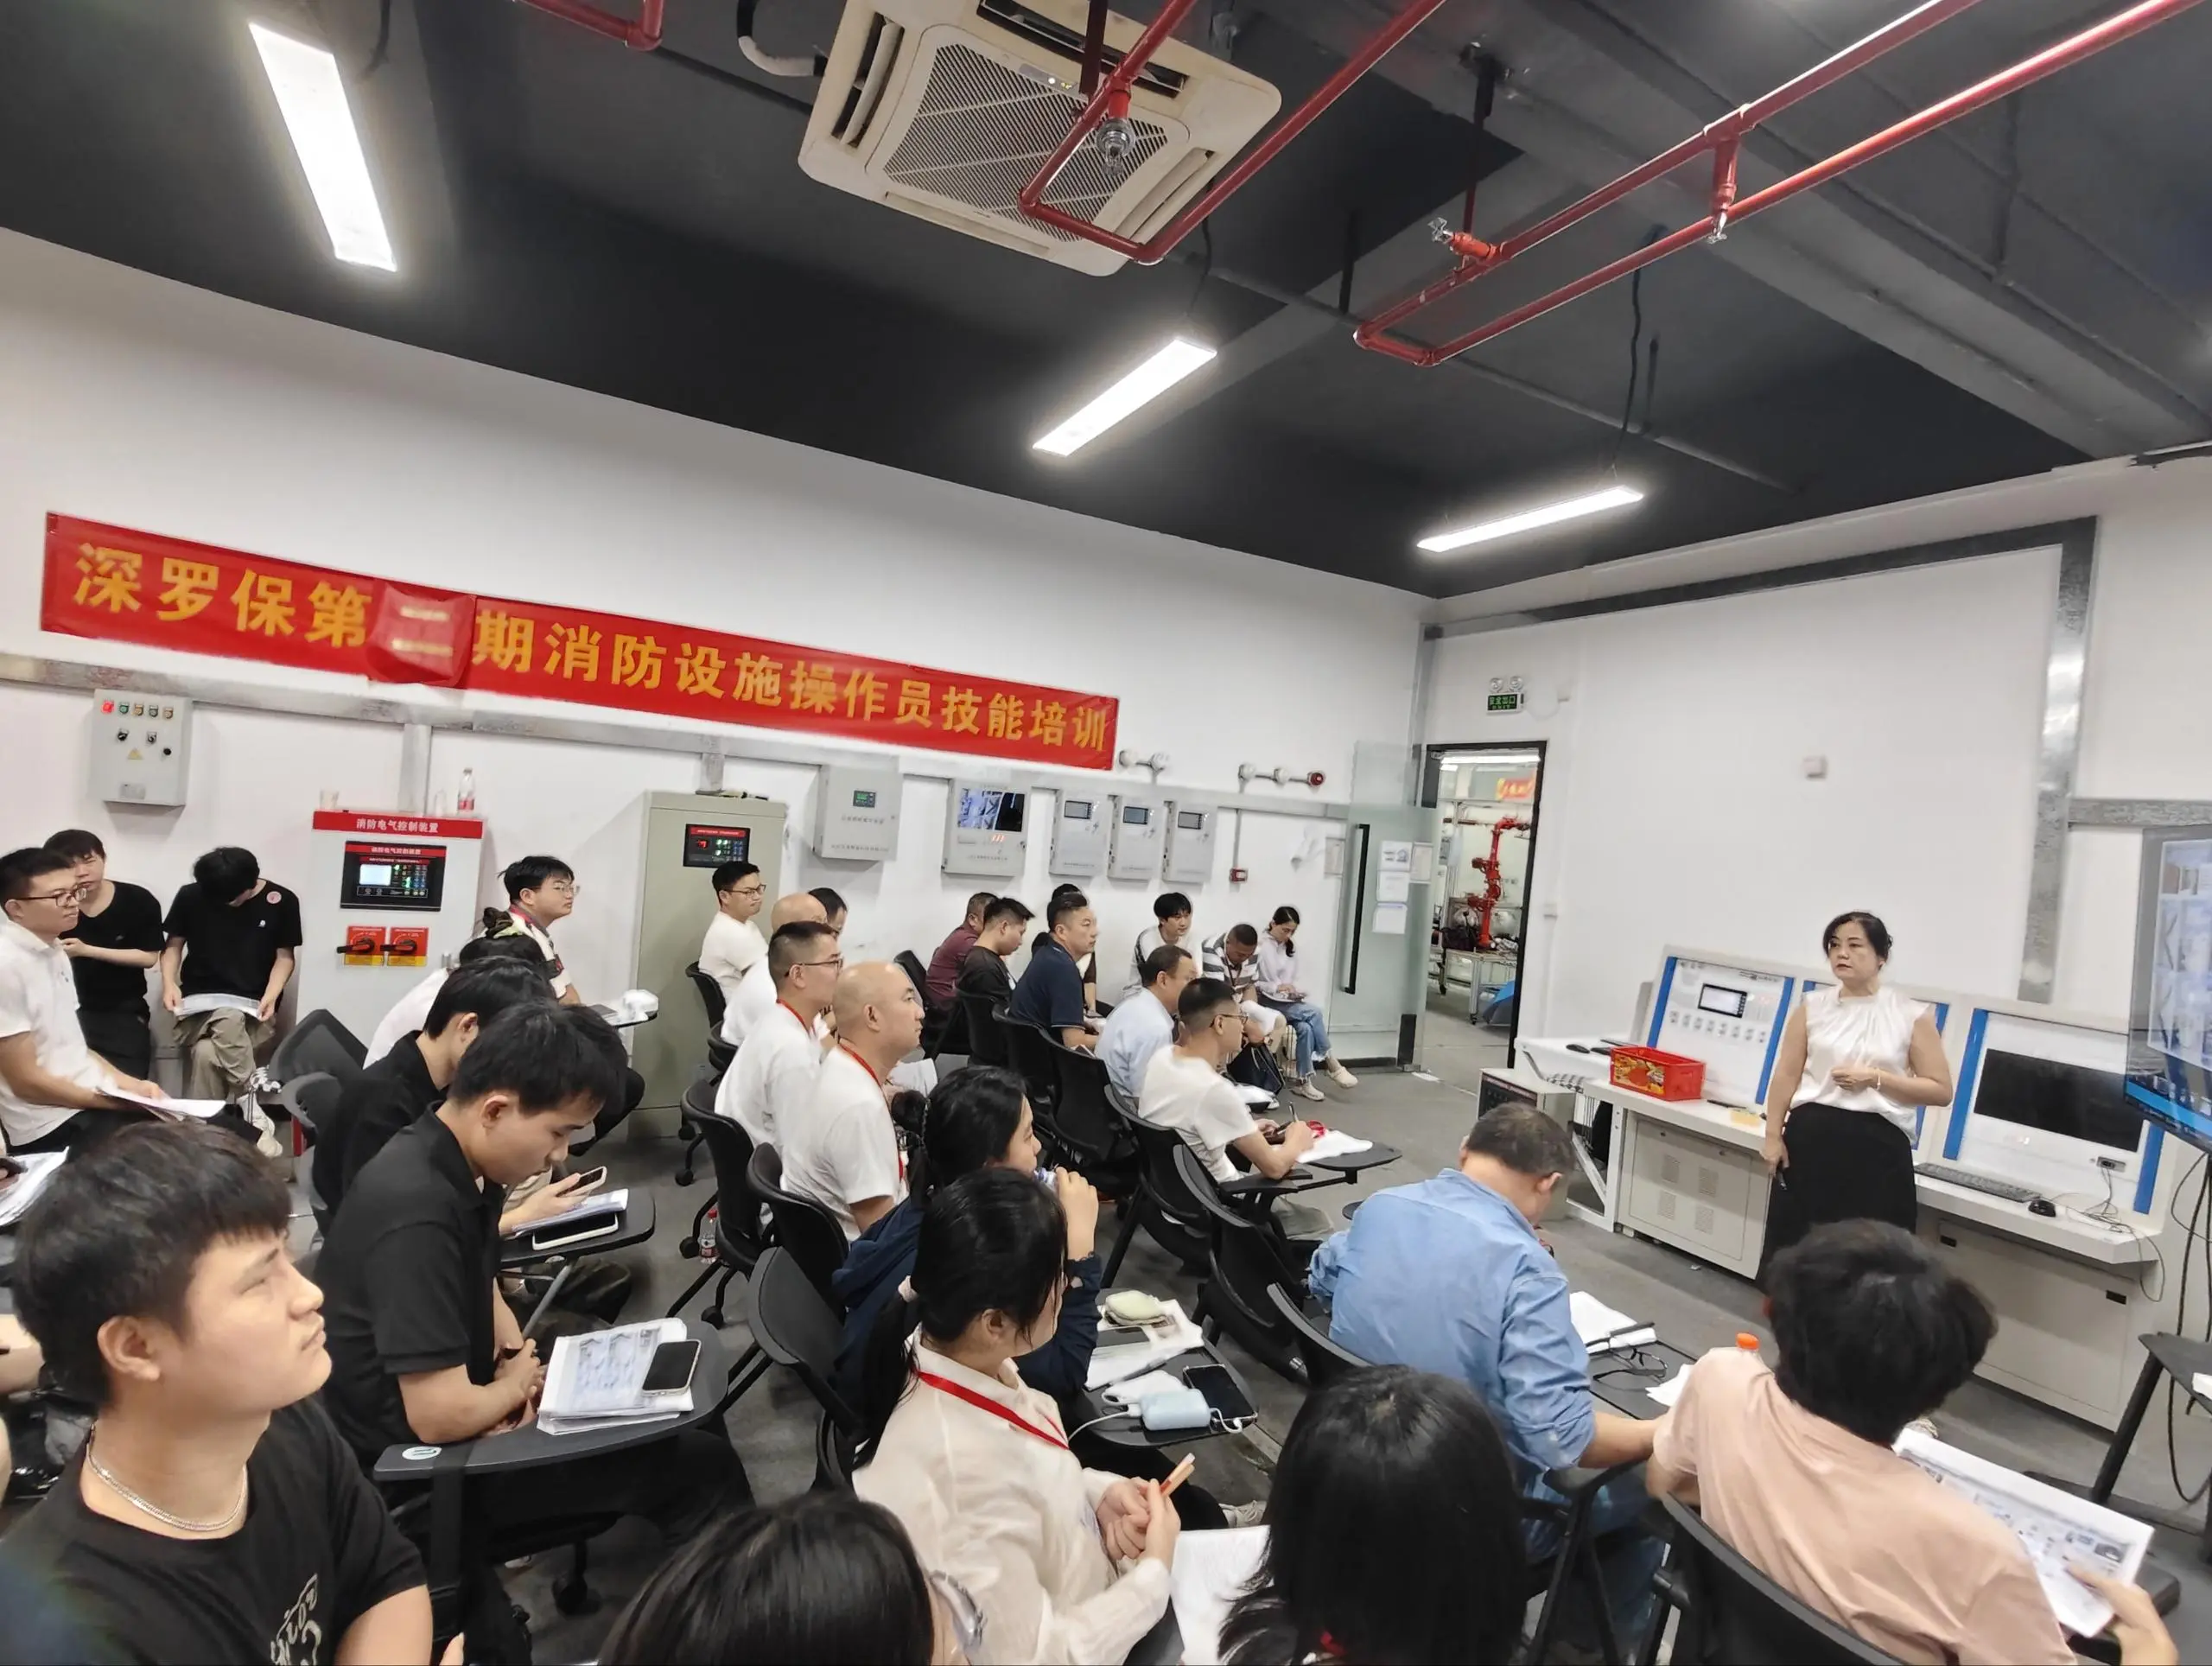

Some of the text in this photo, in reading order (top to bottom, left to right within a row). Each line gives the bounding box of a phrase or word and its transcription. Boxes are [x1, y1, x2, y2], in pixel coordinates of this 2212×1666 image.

[73, 542, 1108, 752] 深罗保第二期消防设施操作员技能培训
[356, 818, 439, 833] 消防电气控制装置
